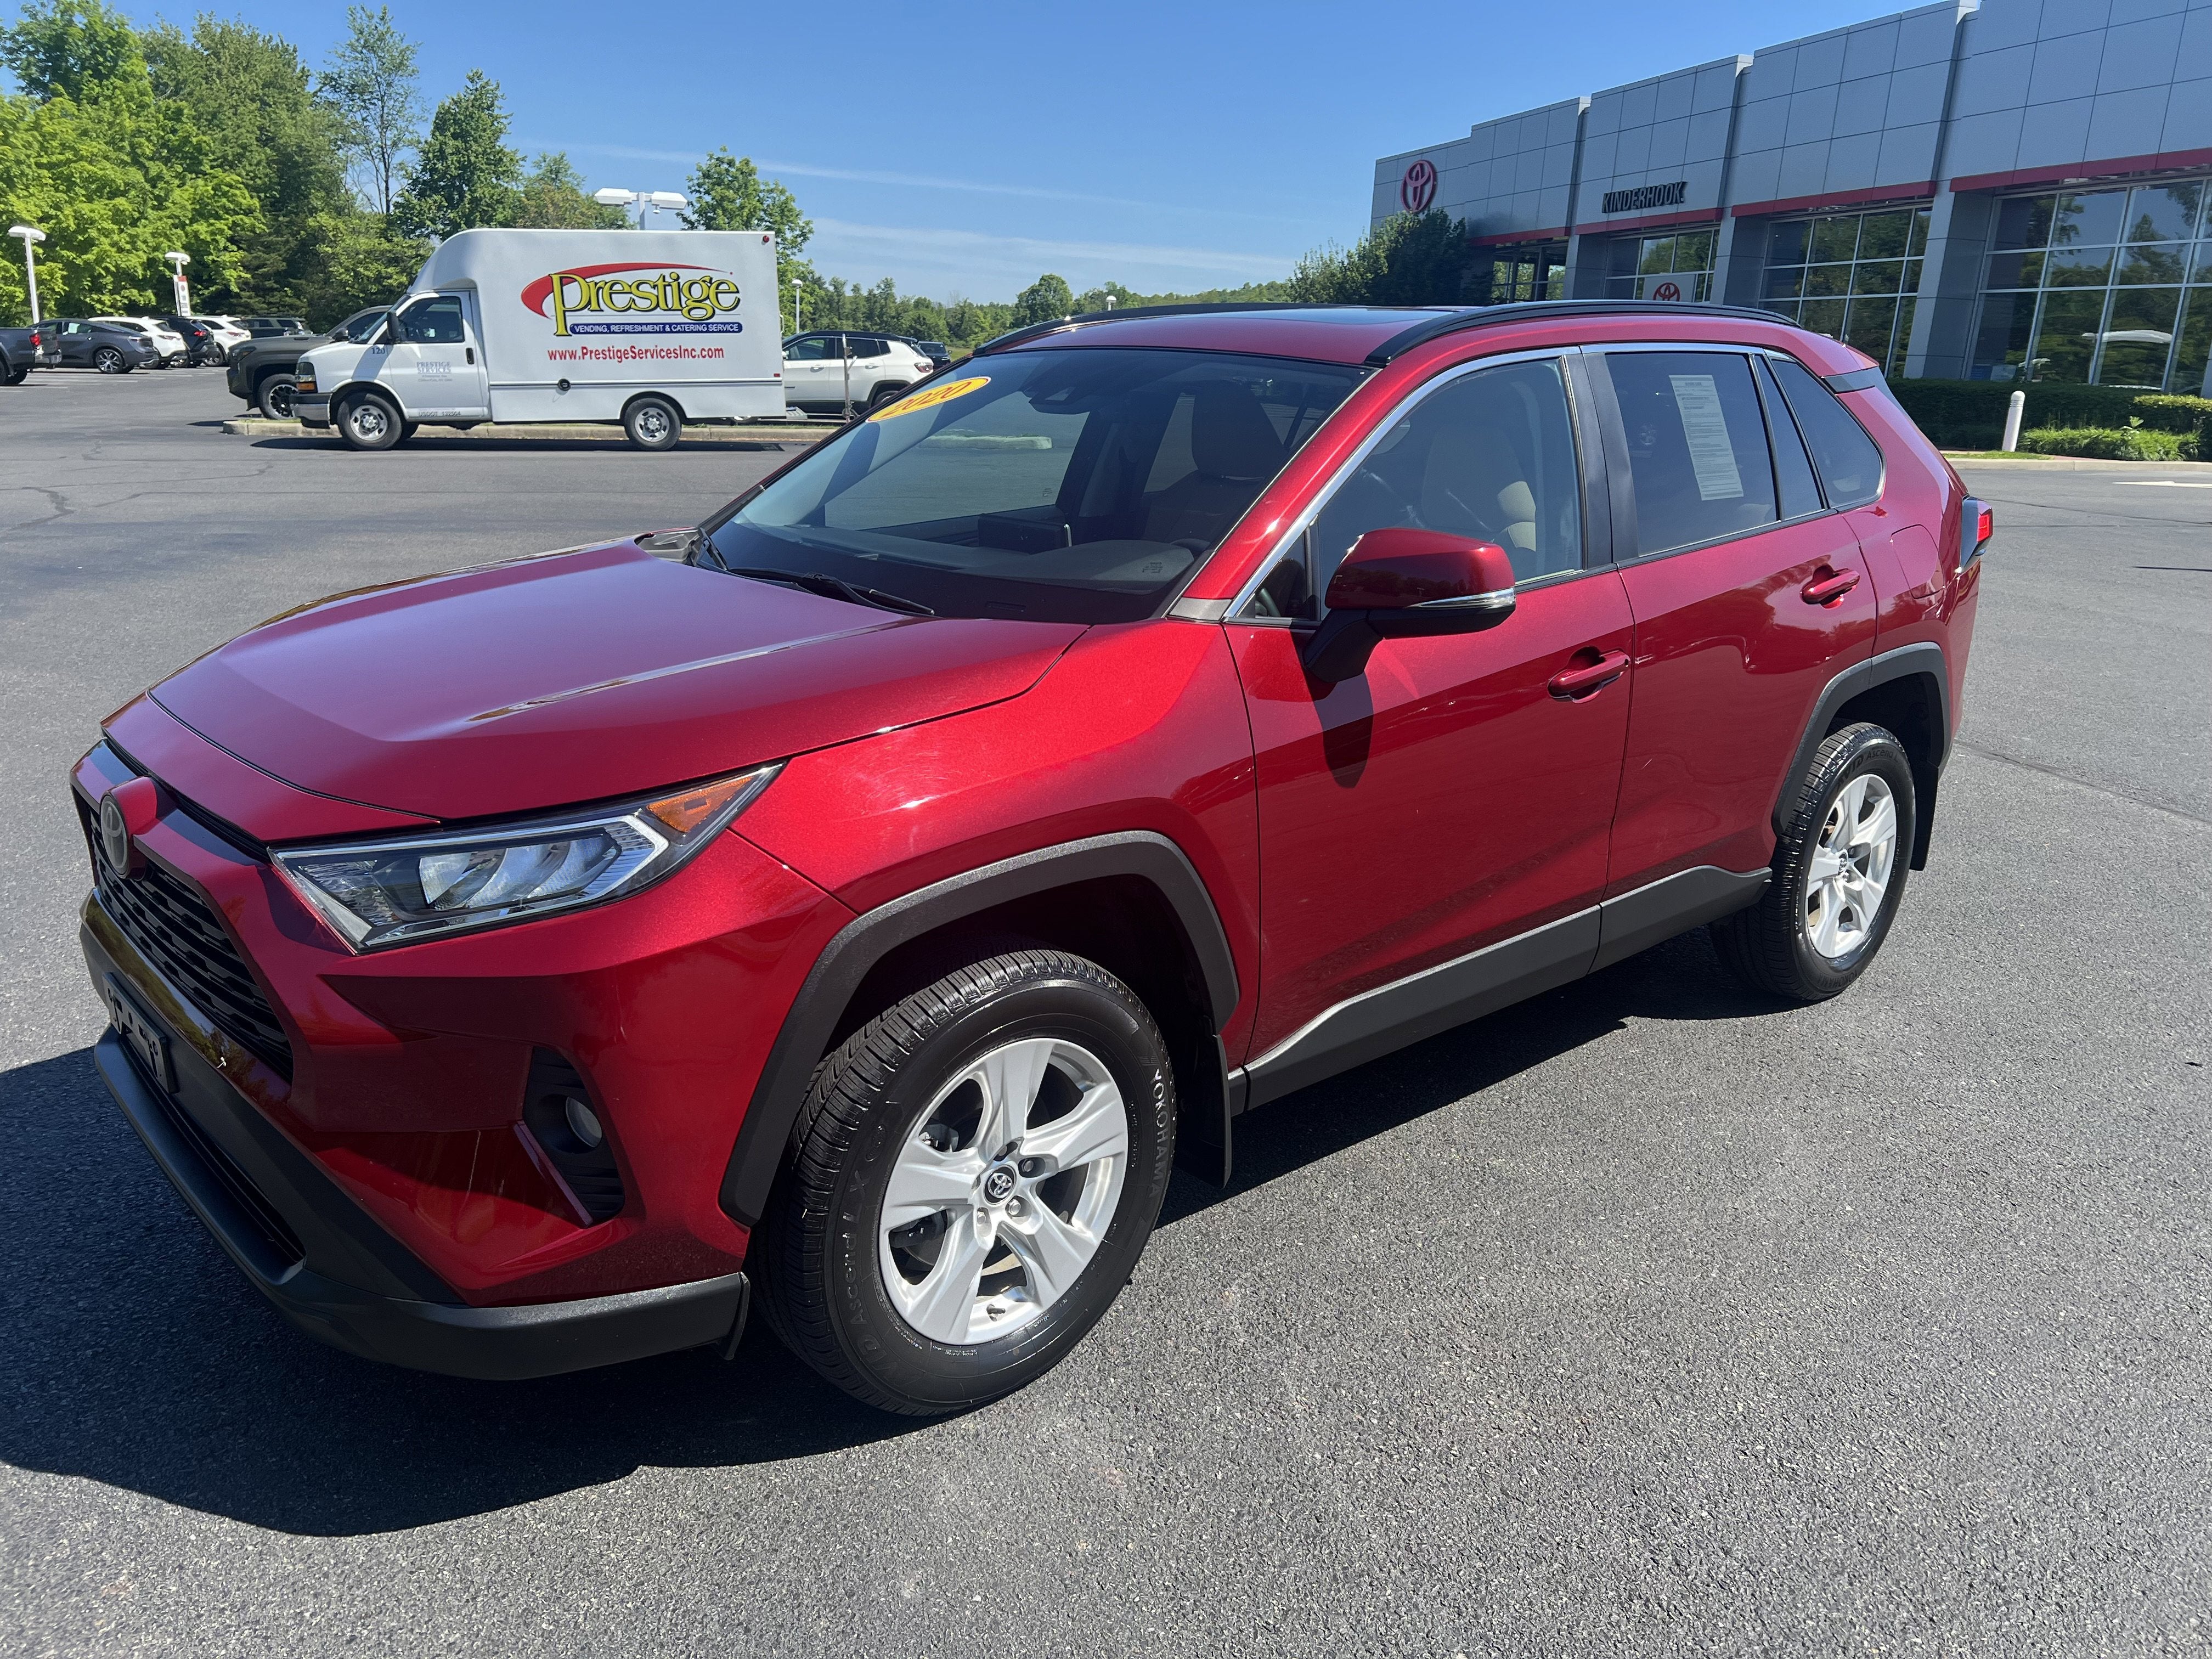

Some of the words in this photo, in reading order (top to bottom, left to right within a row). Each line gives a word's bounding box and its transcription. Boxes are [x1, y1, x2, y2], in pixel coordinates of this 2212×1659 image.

[1602, 181, 1688, 213] KINDERHOOK
[549, 272, 740, 336] Prestige
[574, 325, 610, 333] VENDING,
[548, 345, 724, 363] www.PrestigeServicesInc.com
[879, 381, 972, 419] 2020
[1149, 1068, 1168, 1198] YOKOHAMA
[843, 1232, 868, 1324] Ascend
